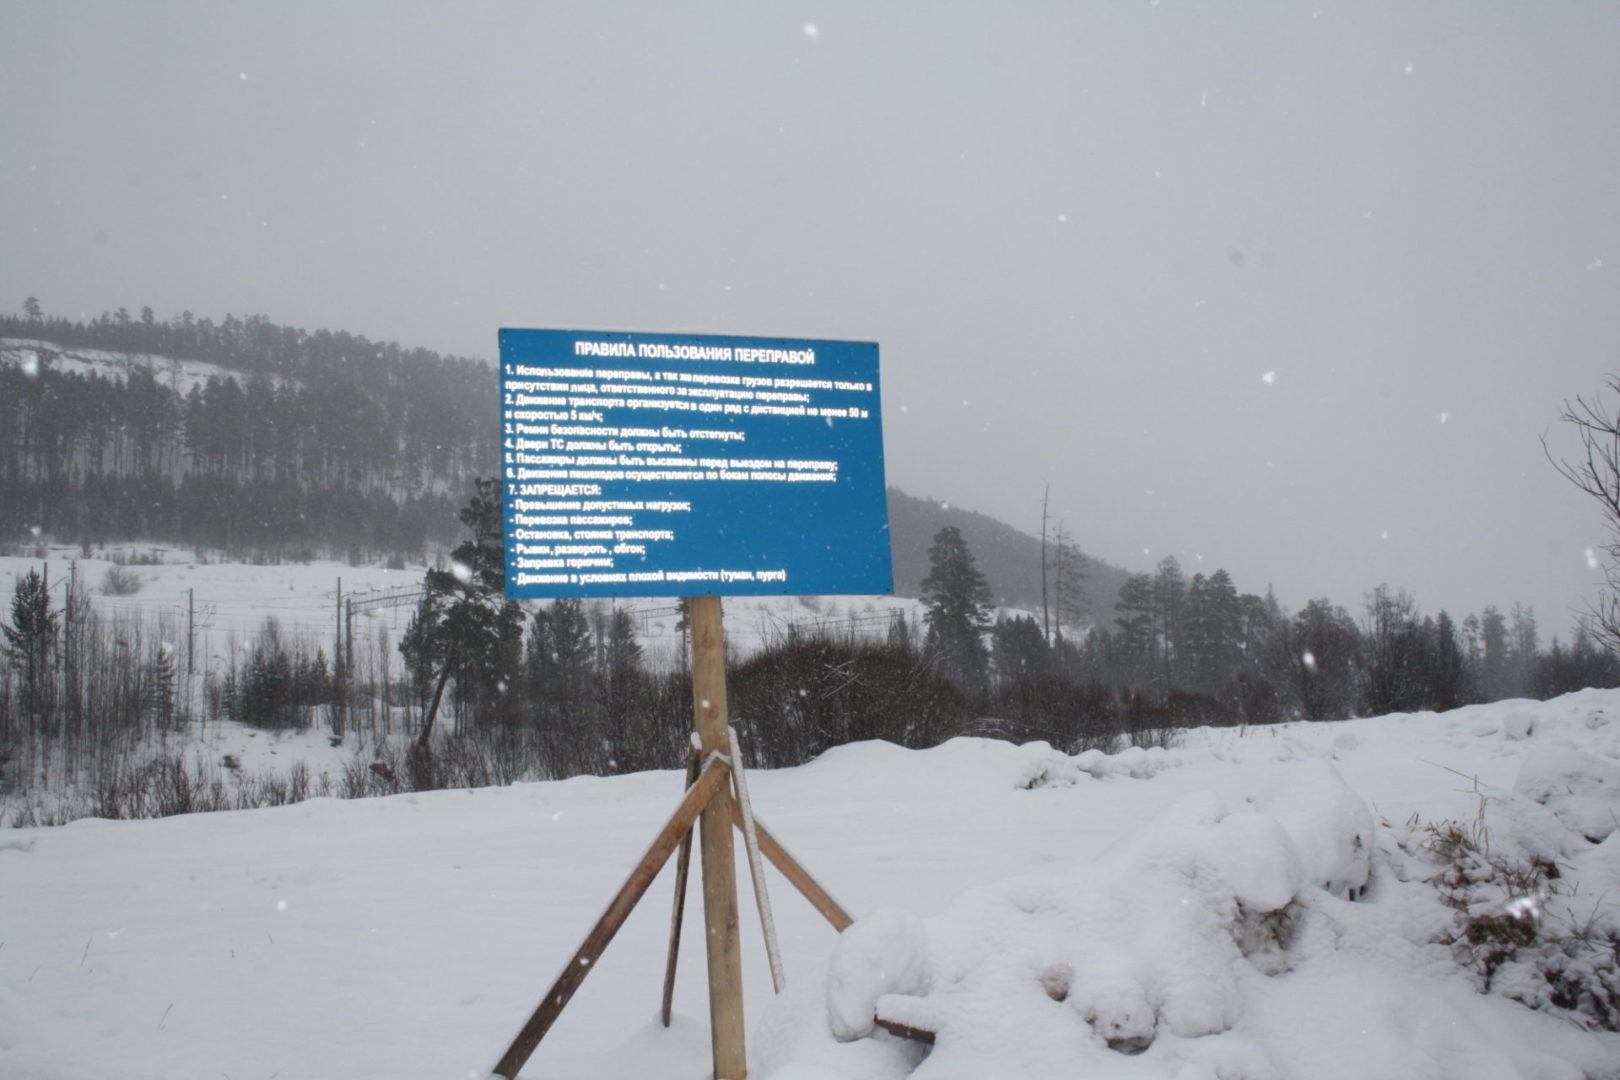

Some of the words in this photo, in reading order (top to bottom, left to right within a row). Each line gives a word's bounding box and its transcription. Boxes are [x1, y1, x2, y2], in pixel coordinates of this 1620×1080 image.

[575, 341, 636, 357] ПРАВИЛА
[639, 343, 732, 360] ПОЛЬЗОВАНИЯ
[735, 347, 815, 364] ПЕРЕПРАВОЙ
[505, 364, 513, 375] 1.
[516, 365, 593, 378] Использование
[596, 369, 652, 381] переправы,
[655, 371, 660, 380] а
[662, 371, 678, 381] так
[680, 373, 692, 382] же
[692, 374, 740, 385] перевозка
[742, 376, 772, 388] грузов
[774, 378, 832, 390] разрешается
[834, 381, 865, 391] только
[866, 383, 872, 391] в
[505, 380, 569, 393] присутствии
[571, 383, 598, 394] лица,
[600, 383, 675, 395] ответственного
[677, 387, 687, 396] за
[688, 388, 754, 400] эксплуатацию
[756, 391, 810, 403] переправы;
[505, 393, 514, 405] 2.
[516, 393, 567, 406] Движение
[568, 397, 625, 409] транспорта
[627, 398, 689, 411] организуется
[690, 402, 697, 411] в
[699, 402, 722, 413] один
[724, 404, 742, 414] ряд
[744, 404, 749, 413] с
[751, 405, 805, 416] дистанцией
[807, 407, 818, 416] не
[820, 408, 847, 417] менее
[849, 407, 859, 418] 50
[861, 410, 868, 418] м
[505, 410, 512, 419] и
[514, 410, 569, 422] скоростью
[571, 409, 577, 421] 5
[579, 410, 603, 422] км/ч;
[505, 422, 513, 434] 3.
[516, 423, 549, 435] Ремни
[551, 423, 618, 436] безопасности
[620, 427, 660, 438] должны
[662, 426, 687, 438] быть
[689, 430, 745, 442] отстегнуты;
[505, 438, 514, 449] 4.
[516, 437, 548, 451] Двери
[550, 438, 564, 450] ТС
[566, 441, 607, 451] должны
[608, 439, 634, 451] быть
[636, 442, 682, 454] открыты;
[505, 452, 514, 464] 5.
[516, 452, 575, 466] Пассажиры
[576, 456, 617, 466] должны
[619, 454, 645, 466] быть
[646, 457, 697, 467] высажены
[700, 458, 728, 470] перед
[730, 459, 772, 470] выездом
[774, 460, 785, 469] на
[787, 460, 838, 472] переправу;
[506, 467, 515, 479] 6.
[517, 467, 568, 480] Движение
[569, 470, 625, 481] пешеходов
[625, 470, 704, 482] осуществляется
[706, 471, 718, 480] по
[720, 468, 749, 480] бокам
[751, 471, 786, 481] полосы
[788, 472, 836, 482] движения;
[508, 484, 518, 495] 7.
[520, 484, 601, 497] ЗАПРЕЩАЕТСЯ:
[515, 498, 581, 512] Превышение
[583, 501, 644, 512] допустимых
[646, 501, 691, 513] нагрузок;
[515, 513, 568, 527] Перевозка
[570, 515, 633, 527] пассажиров;
[516, 528, 572, 541] Остановка,
[574, 530, 613, 540] стоянка
[615, 530, 674, 541] транспорта;
[614, 542, 645, 555] обгон;
[517, 557, 565, 570] Заправка
[567, 558, 614, 569] горючим;
[517, 572, 569, 585] Движение
[571, 574, 577, 583] в
[579, 573, 627, 585] условиях
[629, 570, 664, 582] плохой
[666, 571, 719, 582] видимости
[720, 569, 754, 582] (туман,
[756, 569, 786, 582] пурга)
